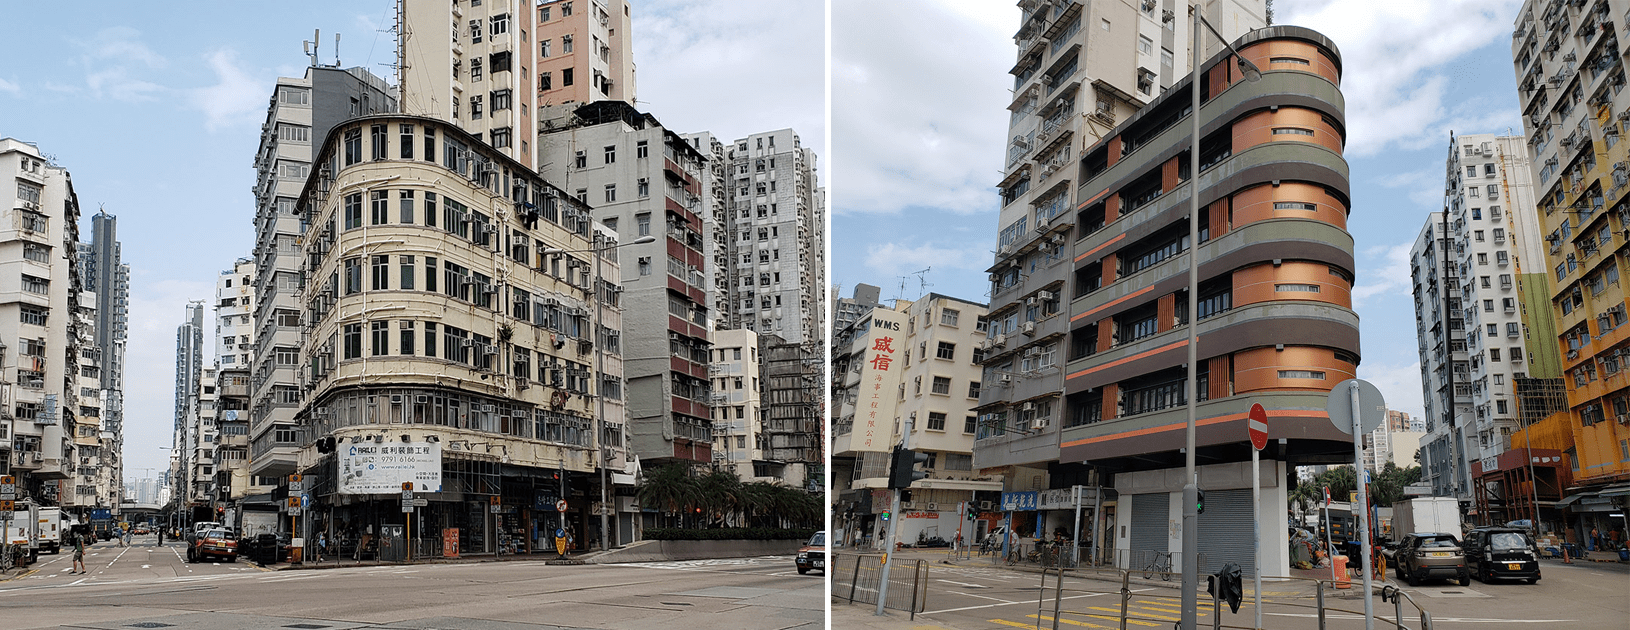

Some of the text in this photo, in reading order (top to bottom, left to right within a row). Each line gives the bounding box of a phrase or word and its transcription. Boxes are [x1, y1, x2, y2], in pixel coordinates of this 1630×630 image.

[381, 446, 430, 454] 威利裝飾工程
